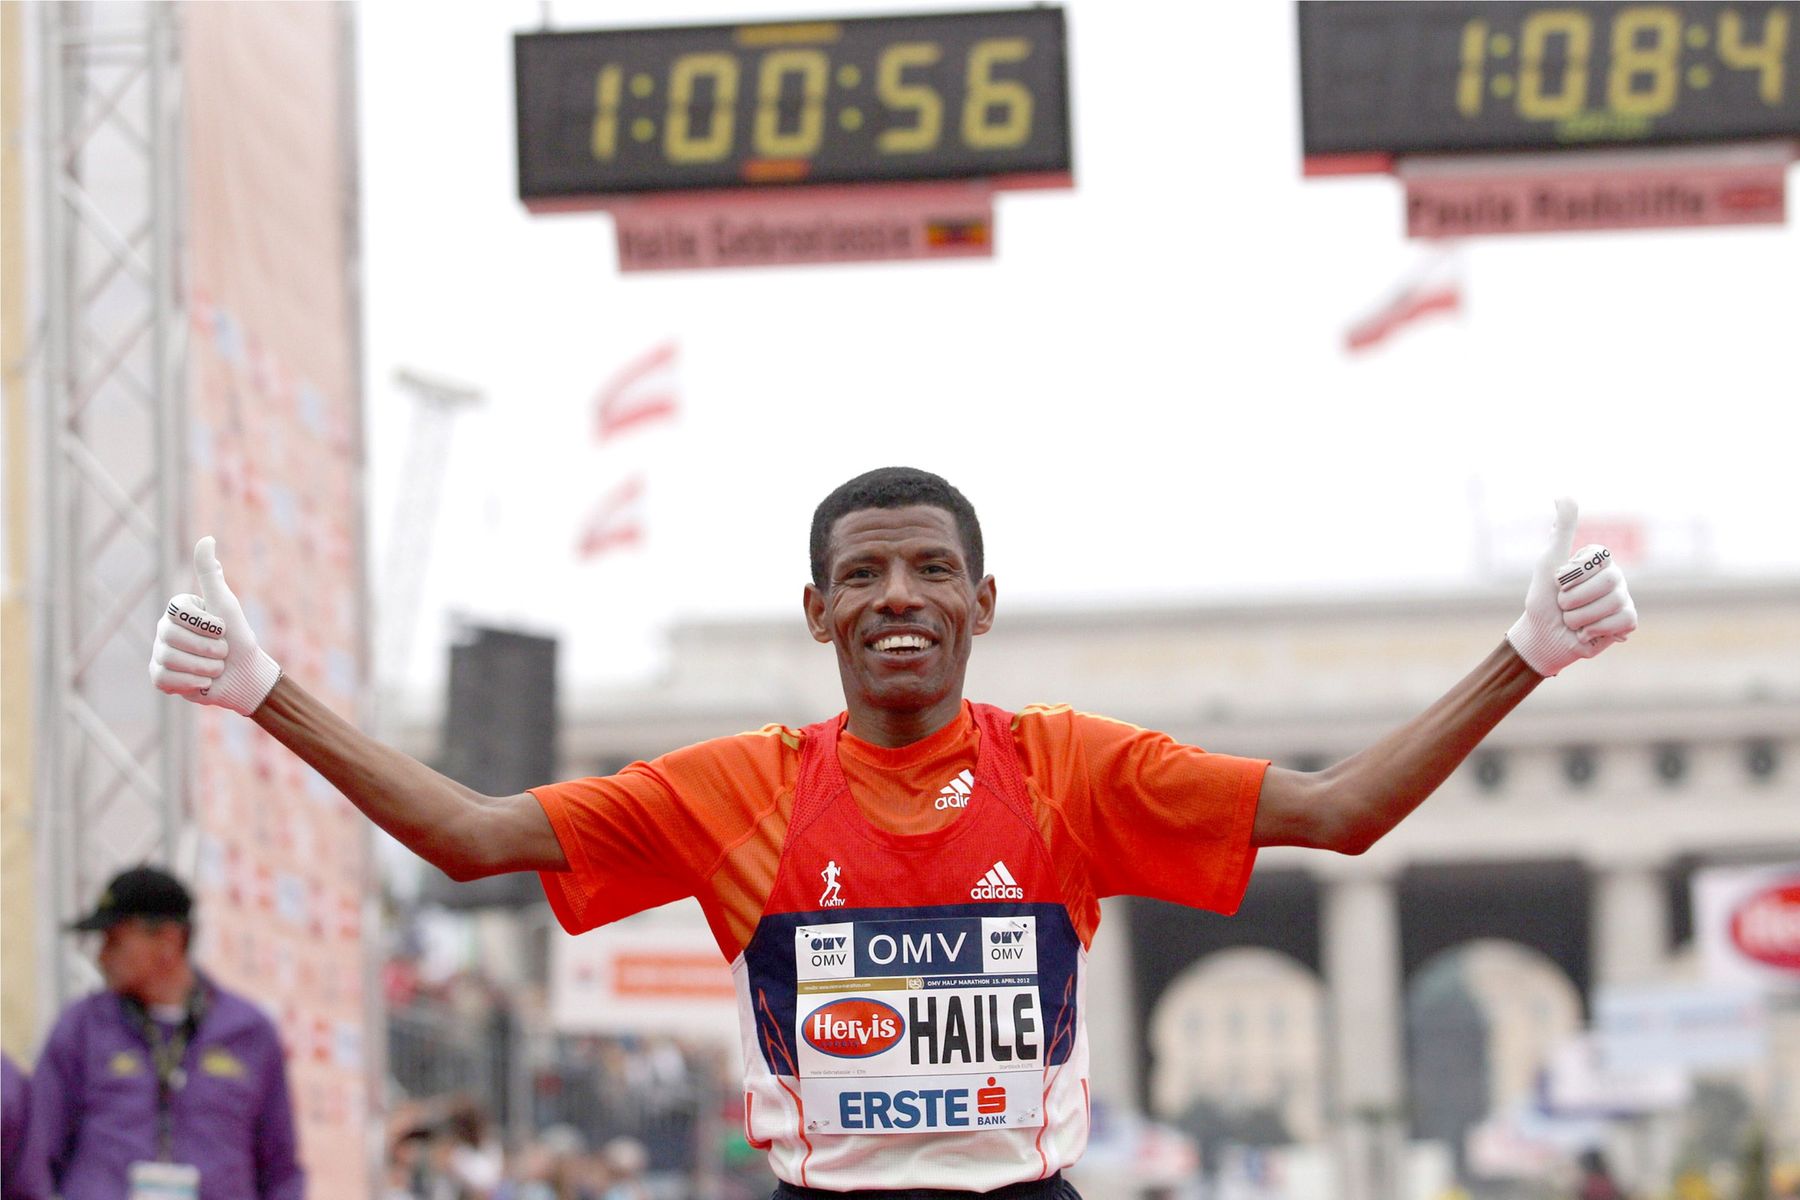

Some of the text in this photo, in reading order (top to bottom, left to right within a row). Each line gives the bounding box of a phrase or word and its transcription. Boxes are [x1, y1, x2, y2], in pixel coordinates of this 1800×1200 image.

[591, 38, 1035, 163] 1:00:56
[179, 612, 223, 636] adidas
[970, 884, 1024, 900] adidas
[811, 954, 847, 967] OMV
[868, 932, 967, 965] OMV
[991, 947, 1024, 960] OMV
[814, 1013, 897, 1045] Hervis
[908, 993, 1038, 1064] HAILE
[839, 1089, 970, 1129] ERSTE
[977, 1115, 1007, 1126] BANK
